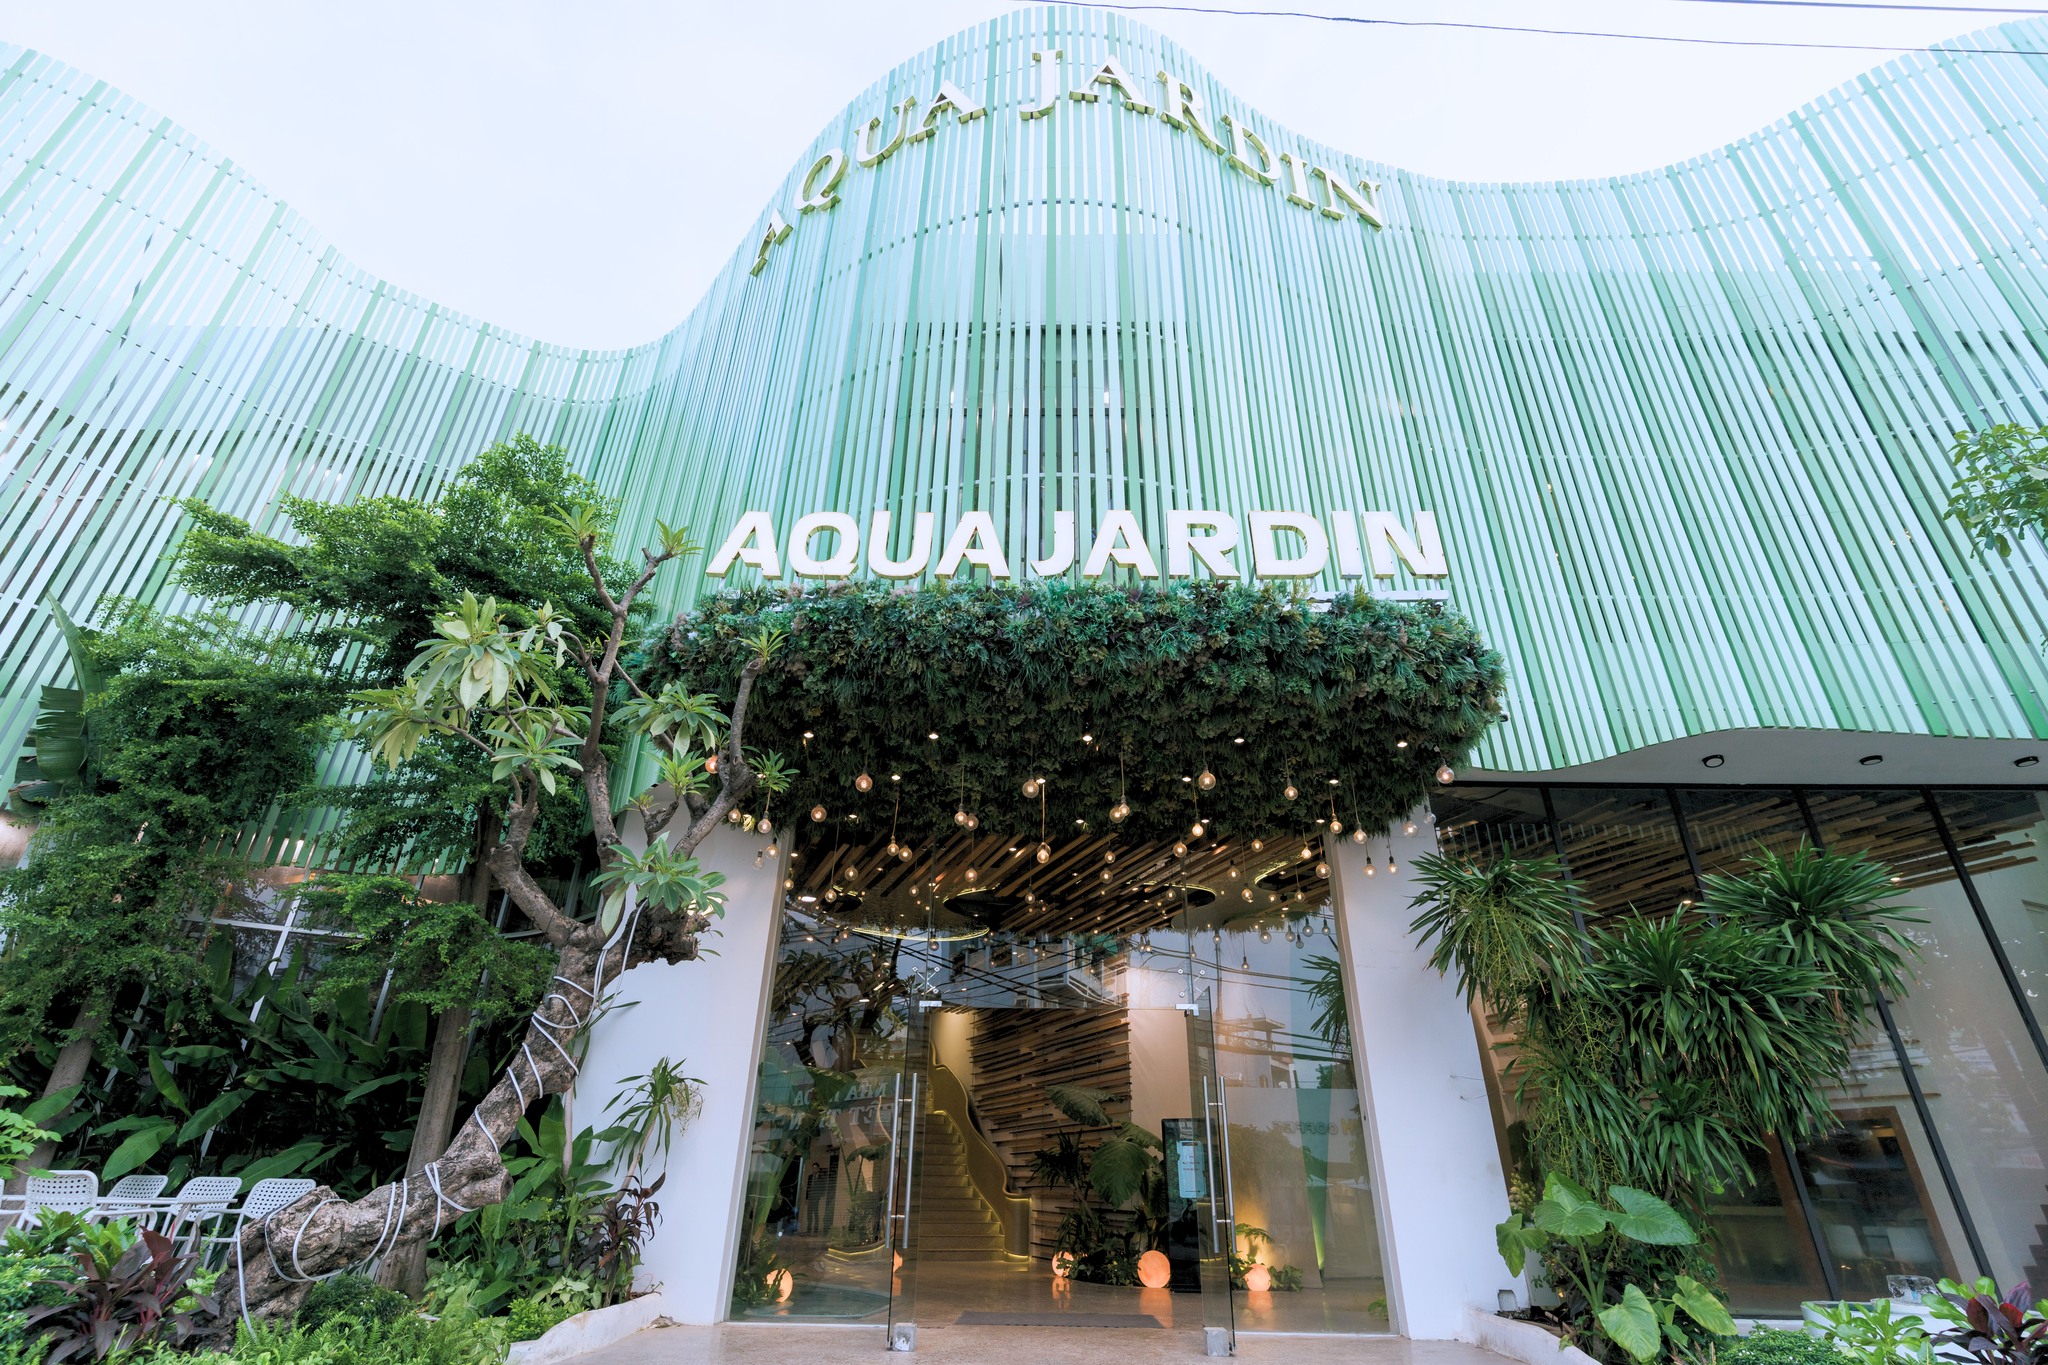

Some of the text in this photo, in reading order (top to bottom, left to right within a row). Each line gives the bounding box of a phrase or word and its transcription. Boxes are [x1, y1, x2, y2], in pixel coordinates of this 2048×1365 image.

[749, 49, 1383, 277] AQUA JARDIN
[705, 510, 1449, 580] AQUA JARDIN
